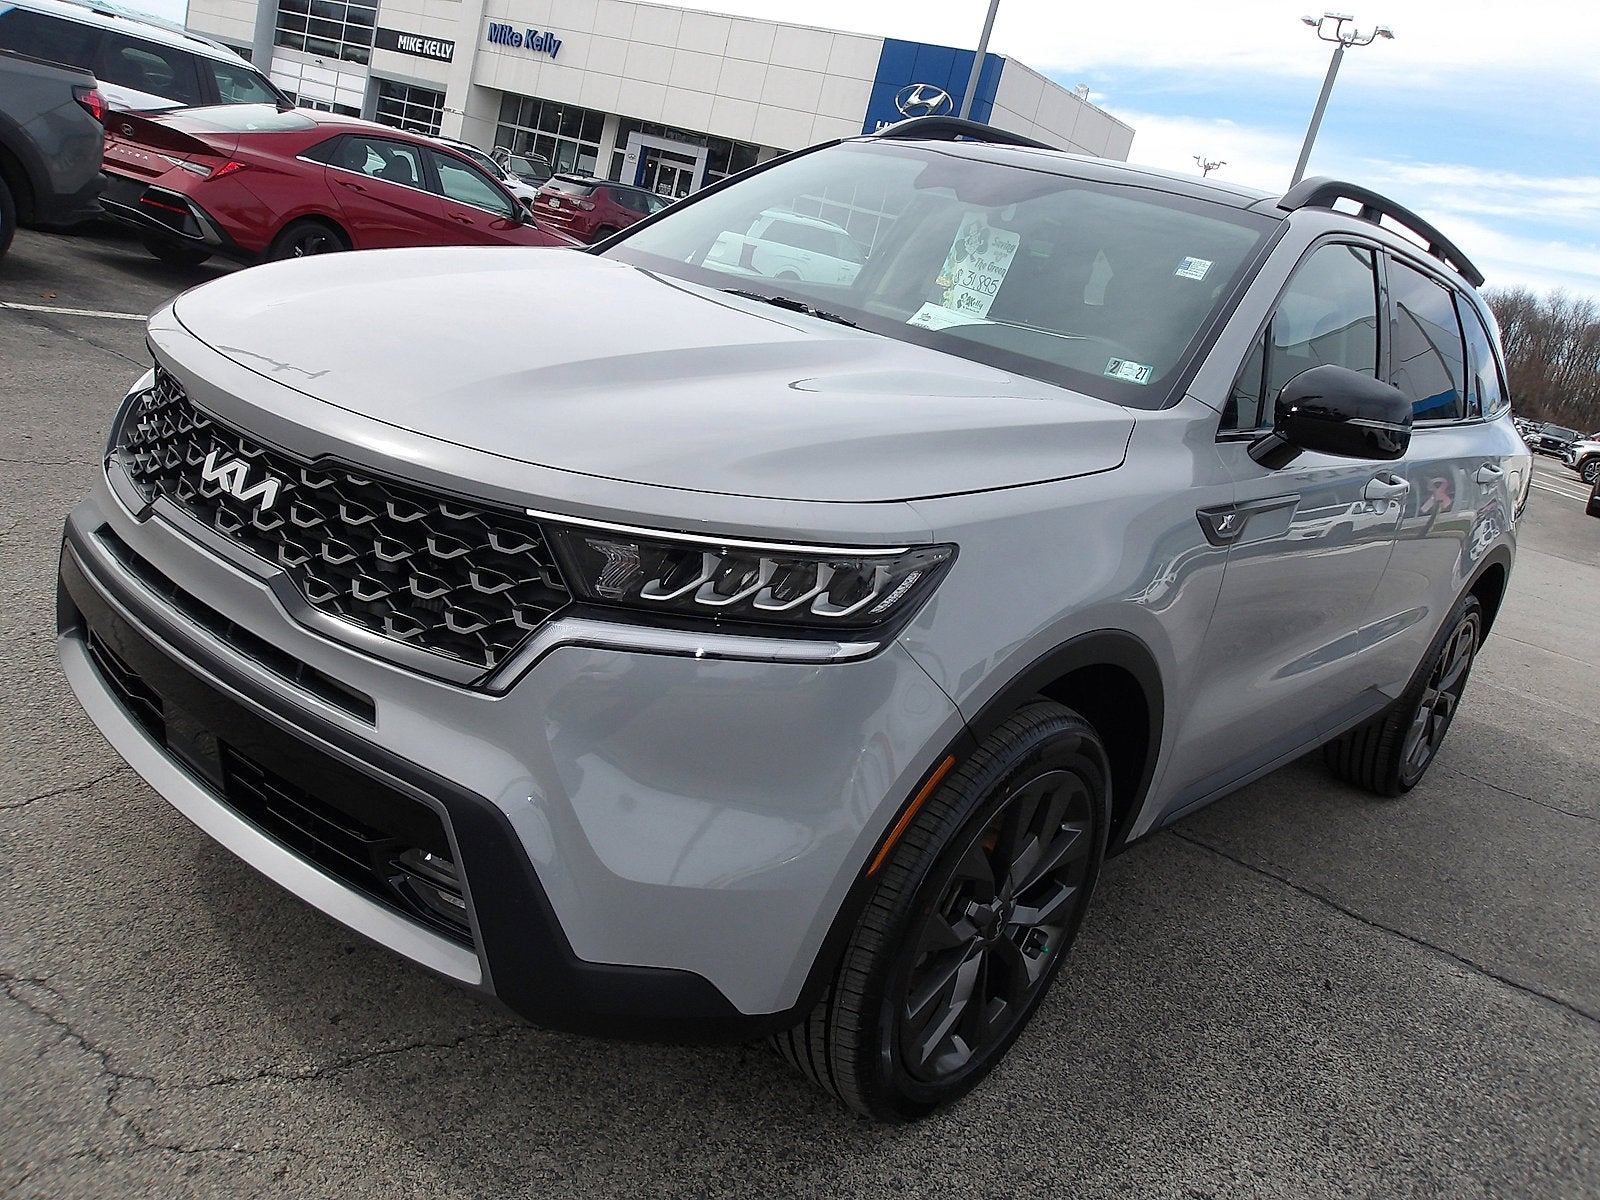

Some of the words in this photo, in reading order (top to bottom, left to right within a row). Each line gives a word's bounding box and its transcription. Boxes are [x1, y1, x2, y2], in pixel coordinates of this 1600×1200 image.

[398, 35, 423, 53] MIKE
[422, 40, 454, 59] KELLY
[488, 22, 522, 47] Mike
[524, 29, 562, 59] Kelly
[1109, 360, 1121, 374] 2
[1134, 366, 1148, 381] 27
[201, 449, 282, 512] KIA
